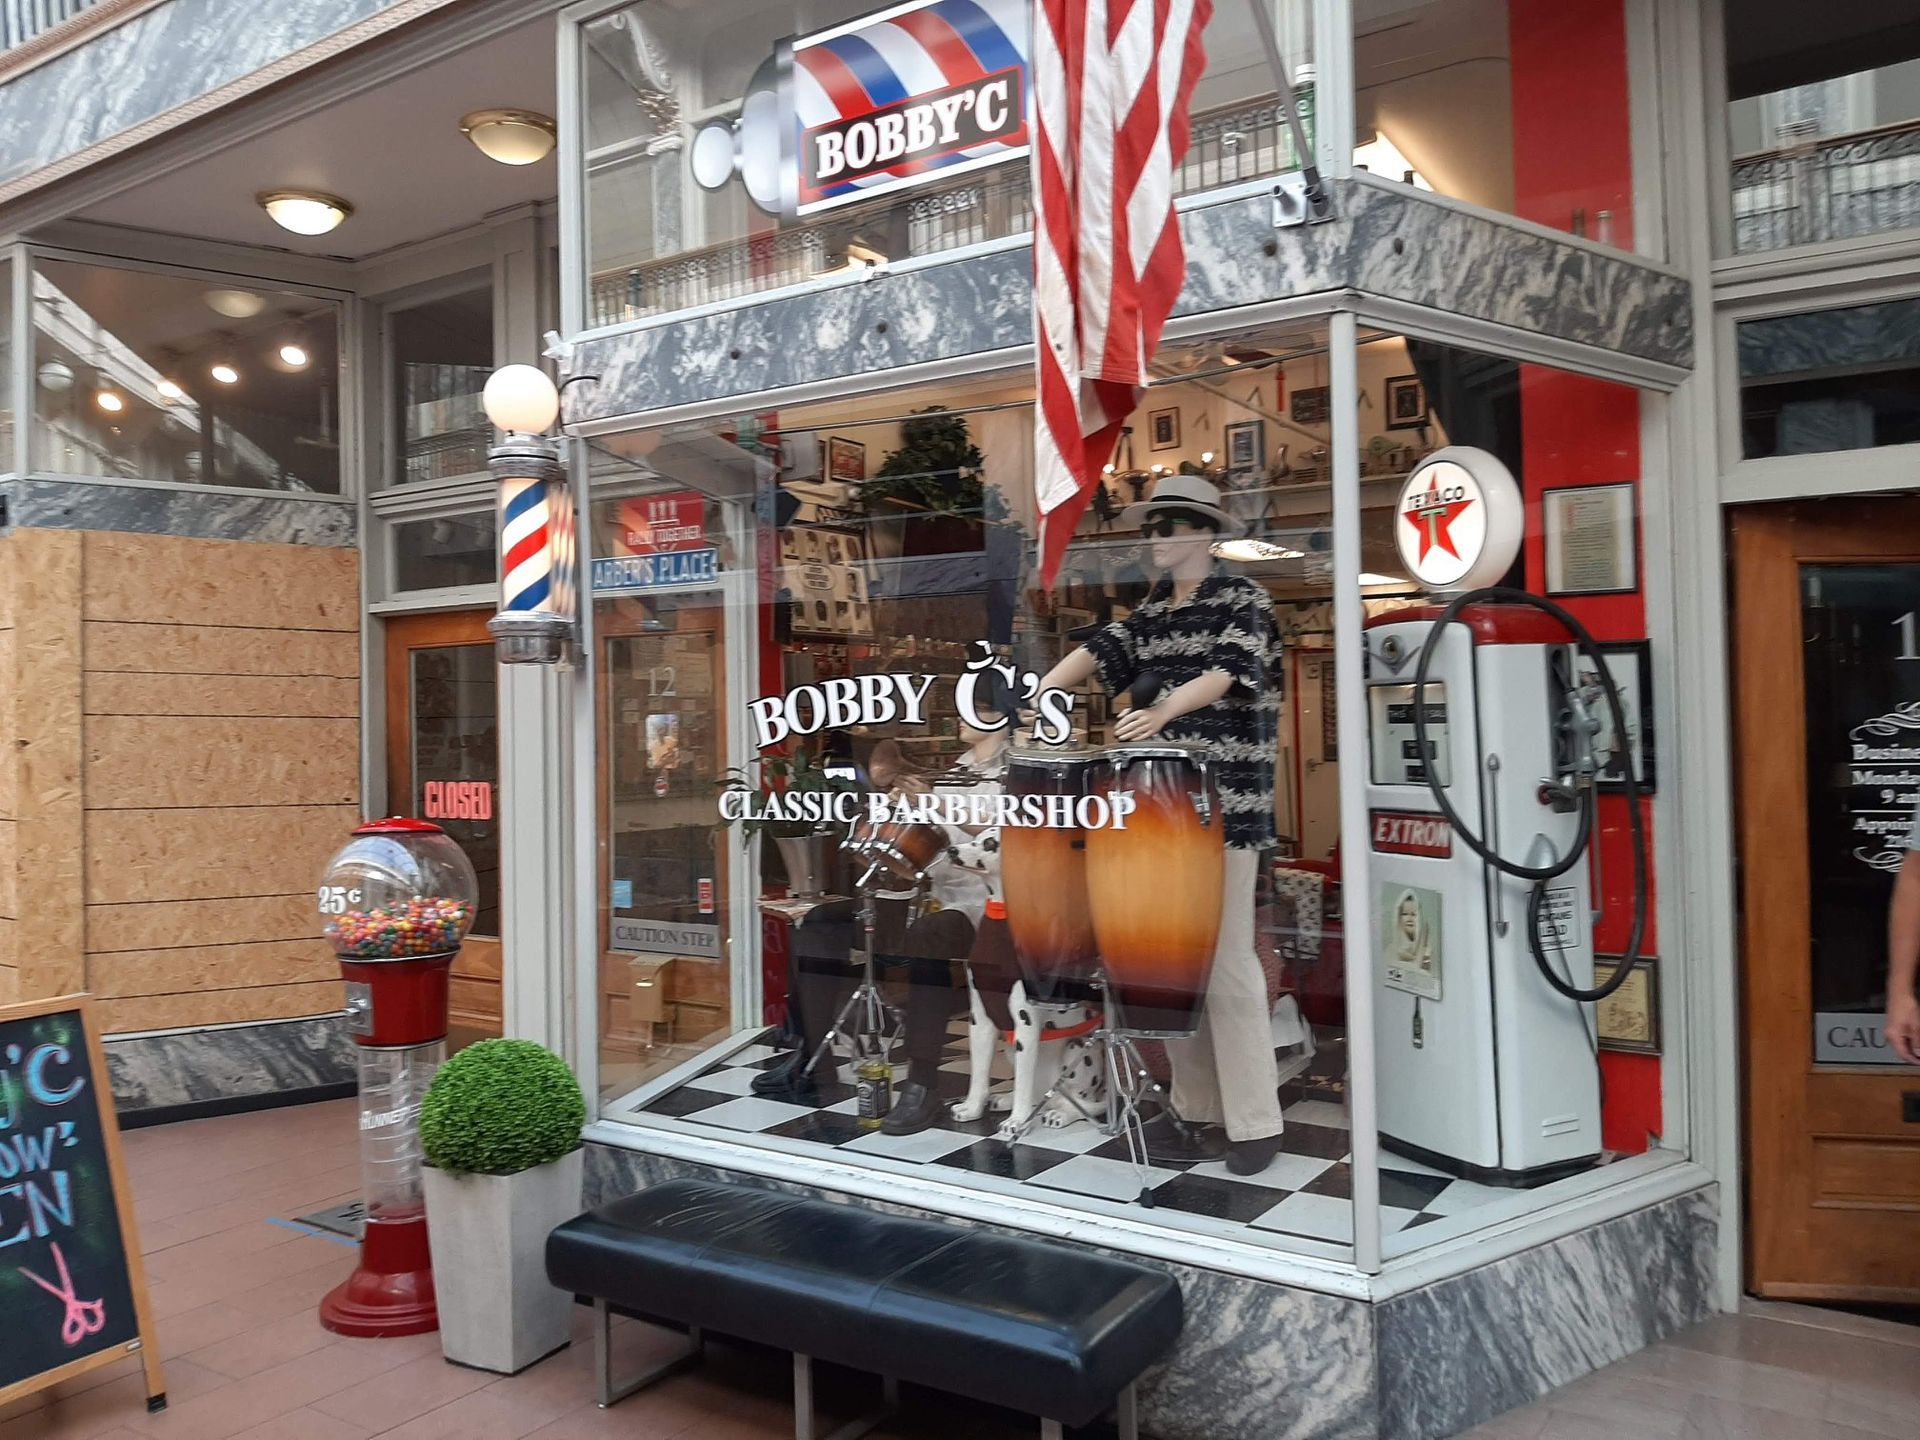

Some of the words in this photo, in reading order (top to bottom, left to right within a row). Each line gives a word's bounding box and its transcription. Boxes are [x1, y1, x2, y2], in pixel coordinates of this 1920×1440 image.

[815, 79, 1009, 179] BOBBY'C
[1406, 486, 1466, 511] TEXACO
[660, 552, 711, 582] PLACE
[647, 666, 677, 697] 12
[747, 672, 939, 749] BOBBY
[424, 780, 493, 820] CLOSED
[718, 790, 859, 823] CLASSIC
[866, 791, 1138, 831] BARBERSHOP
[615, 926, 678, 945] CAUTION
[680, 930, 715, 947] STEP
